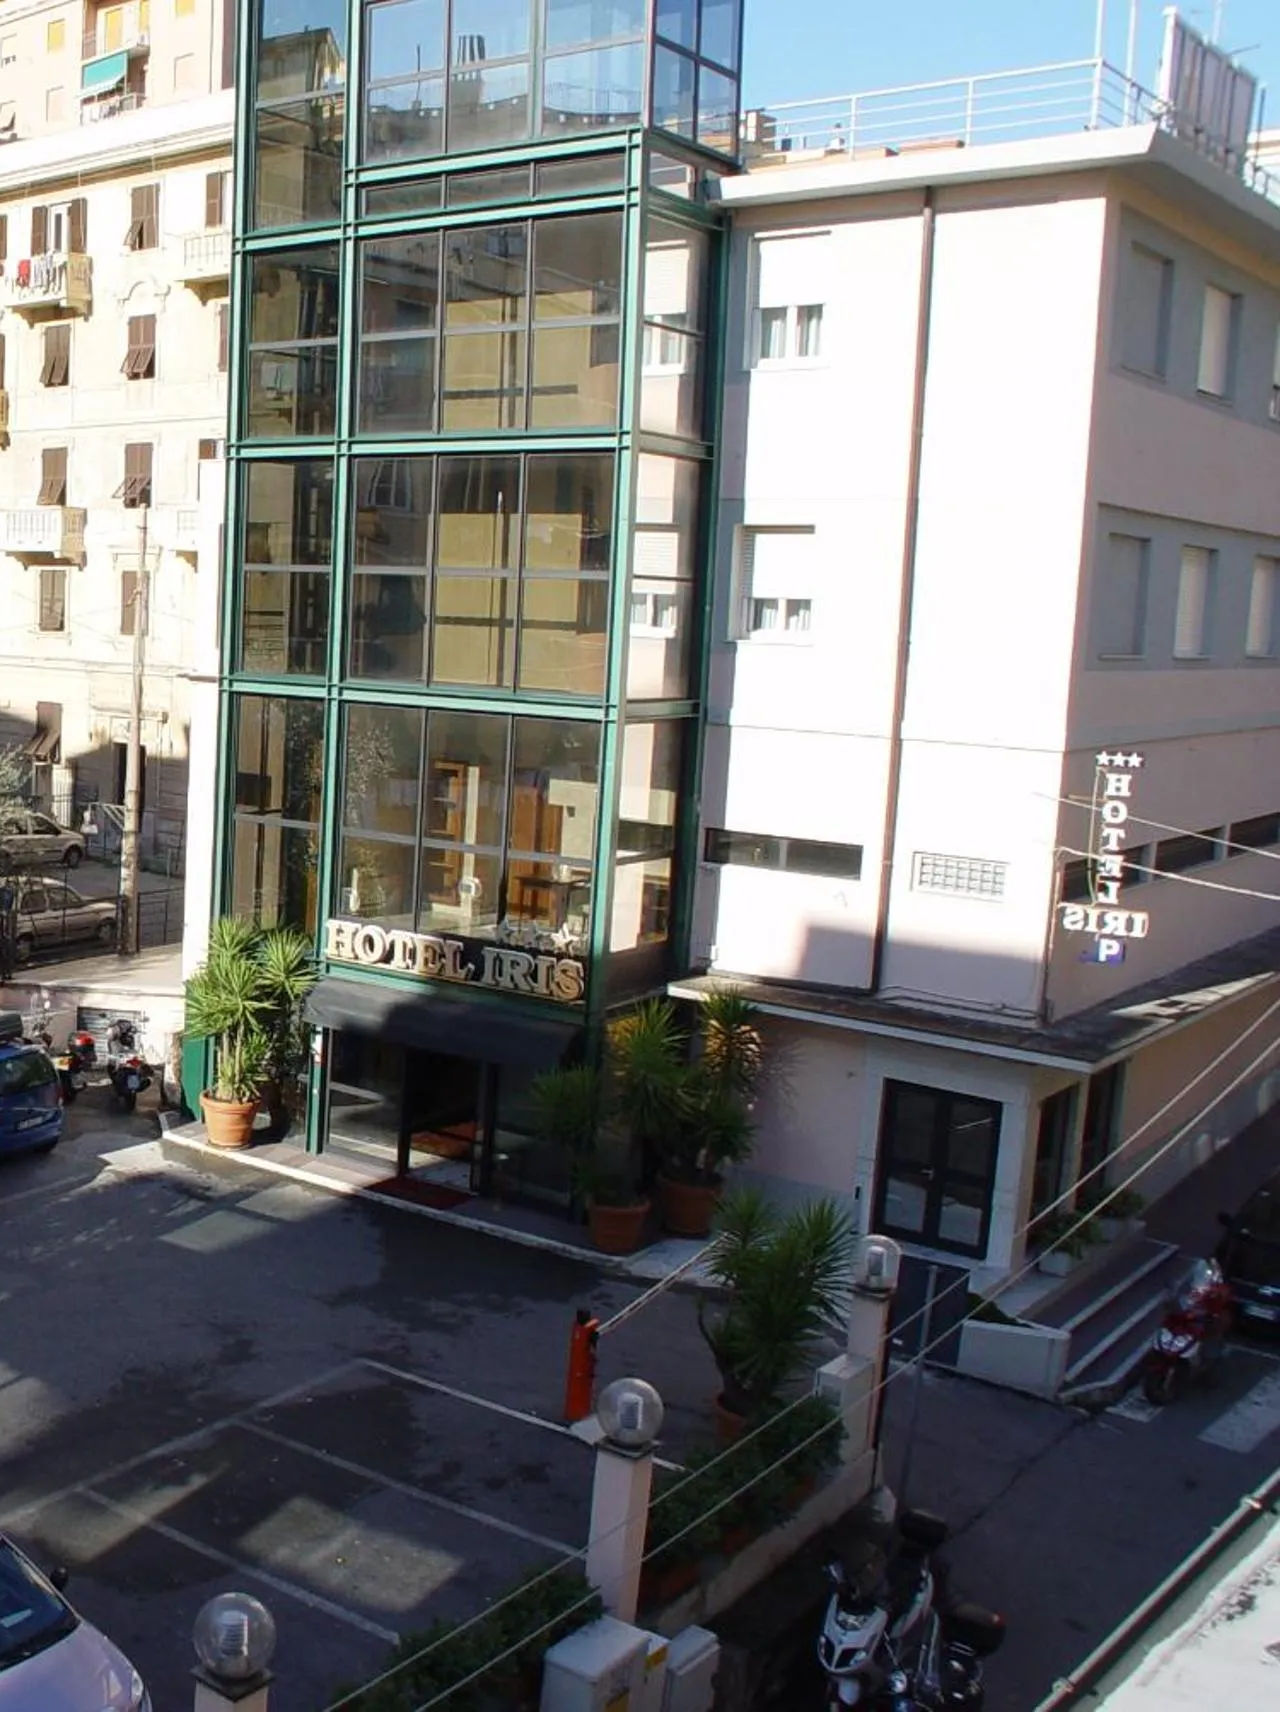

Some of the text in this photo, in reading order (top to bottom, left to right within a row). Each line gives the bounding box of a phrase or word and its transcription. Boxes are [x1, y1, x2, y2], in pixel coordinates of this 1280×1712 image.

[327, 919, 585, 1000] HOTEL IRIS
[1098, 938, 1121, 962] P
